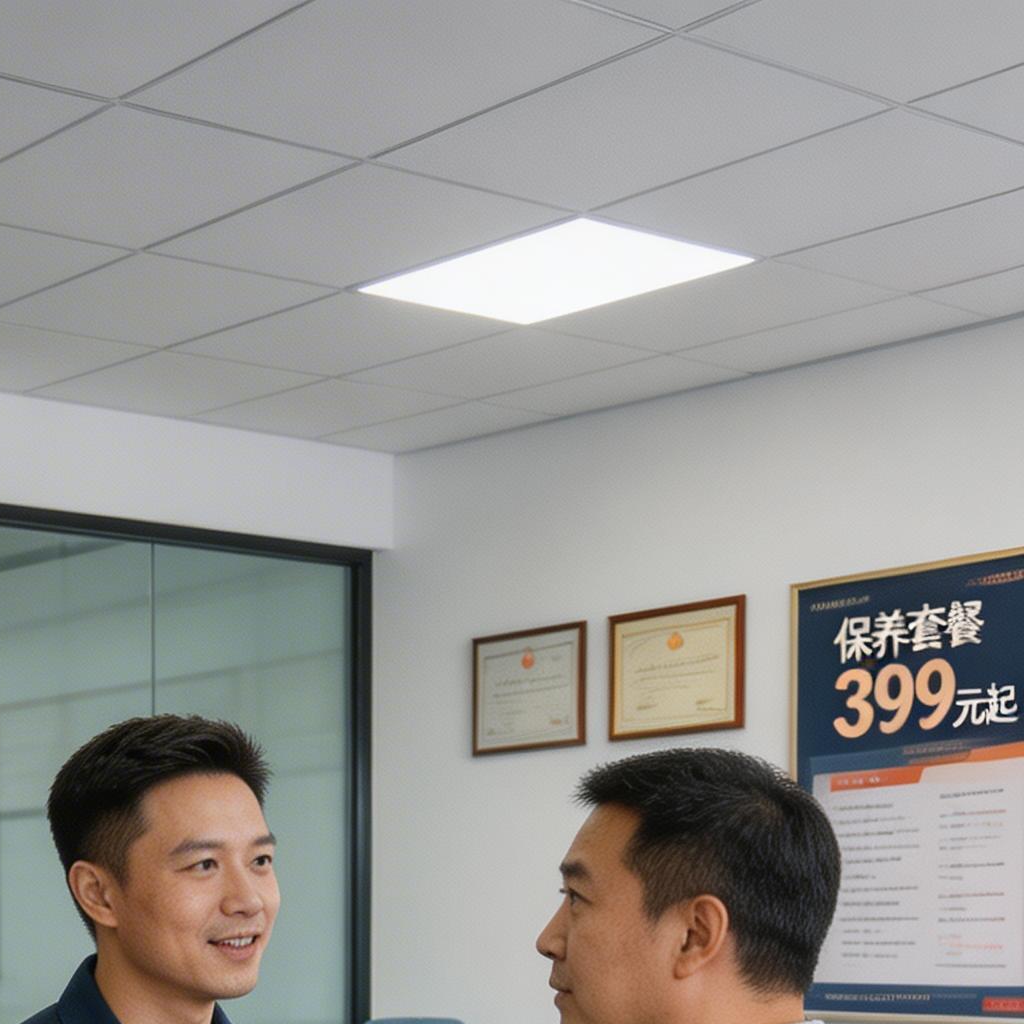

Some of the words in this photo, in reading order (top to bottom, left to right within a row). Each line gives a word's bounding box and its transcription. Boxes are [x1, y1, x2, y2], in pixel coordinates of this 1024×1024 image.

[833, 600, 985, 664] 保养套餐
[833, 658, 1019, 738] 399元起
